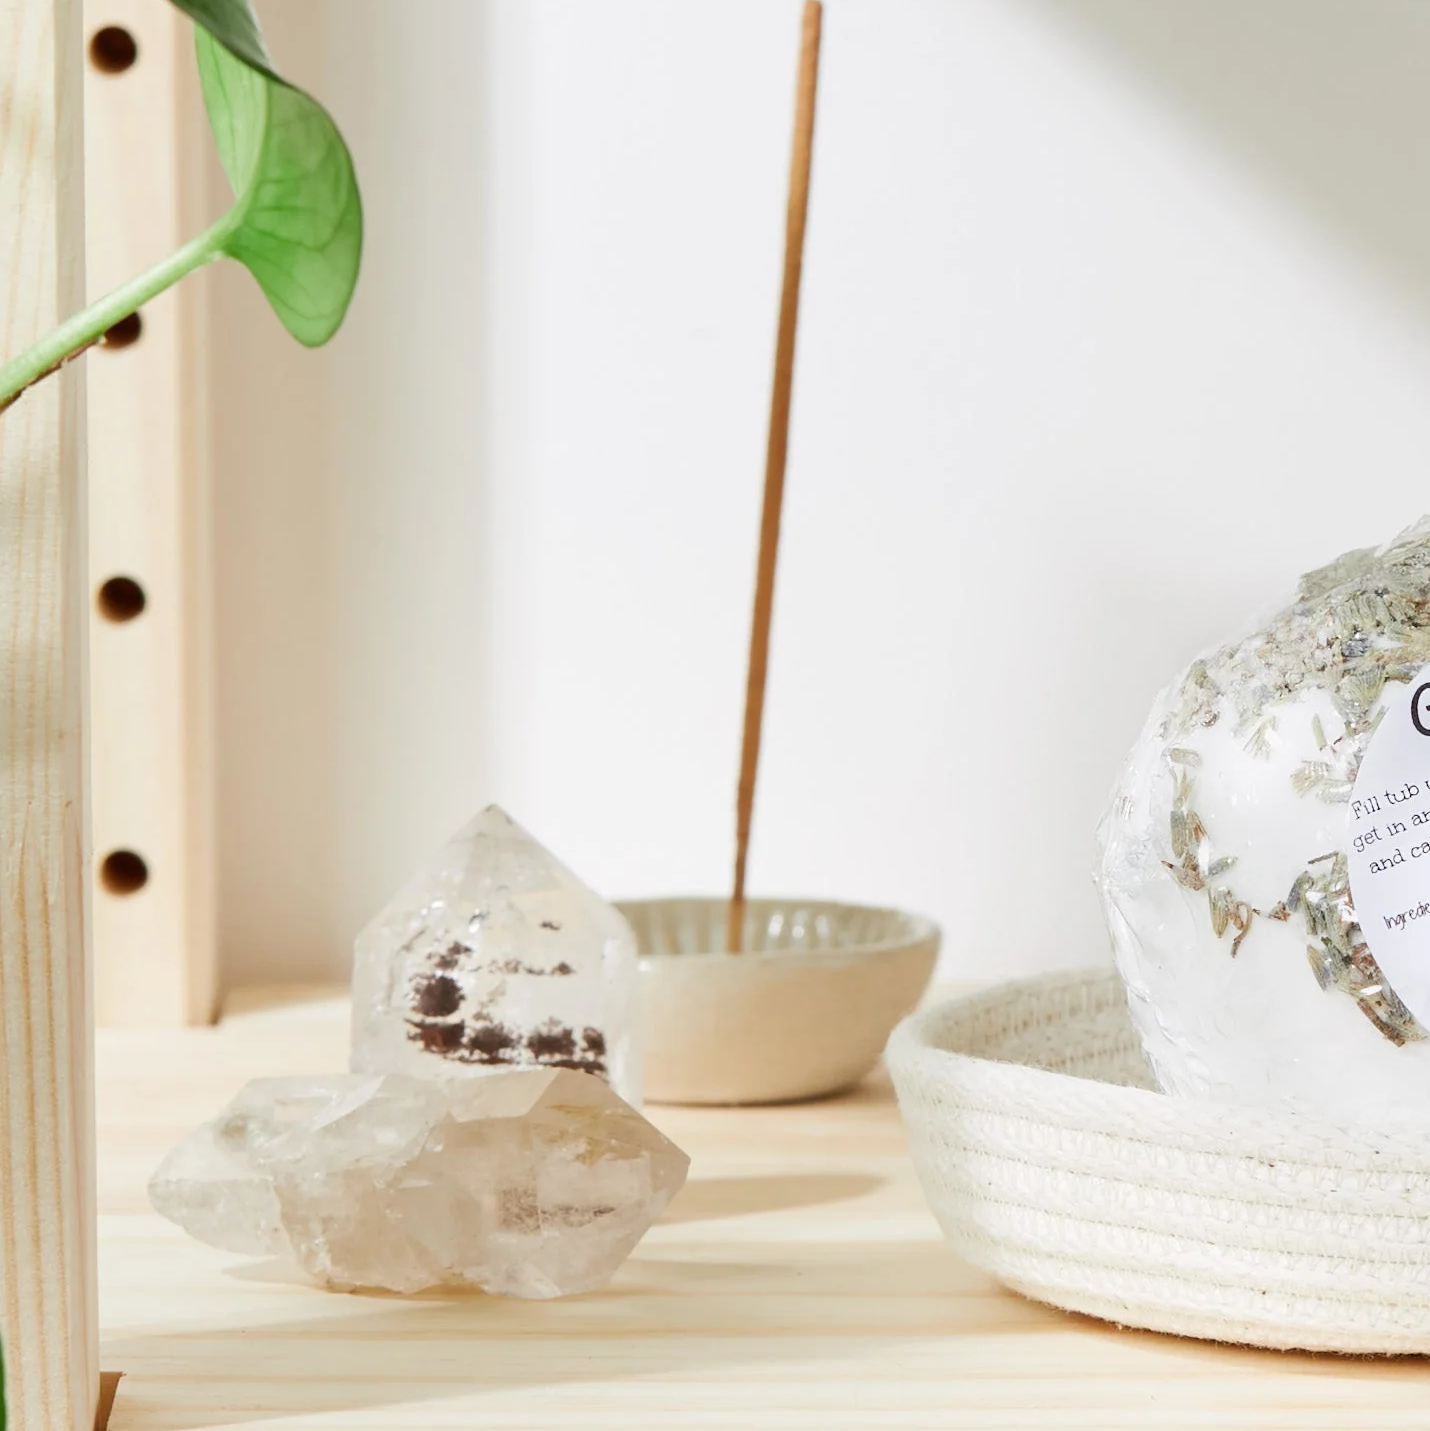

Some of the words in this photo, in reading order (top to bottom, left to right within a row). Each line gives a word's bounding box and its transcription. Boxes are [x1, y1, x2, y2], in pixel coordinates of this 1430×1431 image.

[1351, 796, 1381, 820] Fill
[1384, 784, 1419, 805] tub
[1353, 827, 1383, 853] get
[1388, 821, 1407, 836] in
[1369, 849, 1406, 874] and
